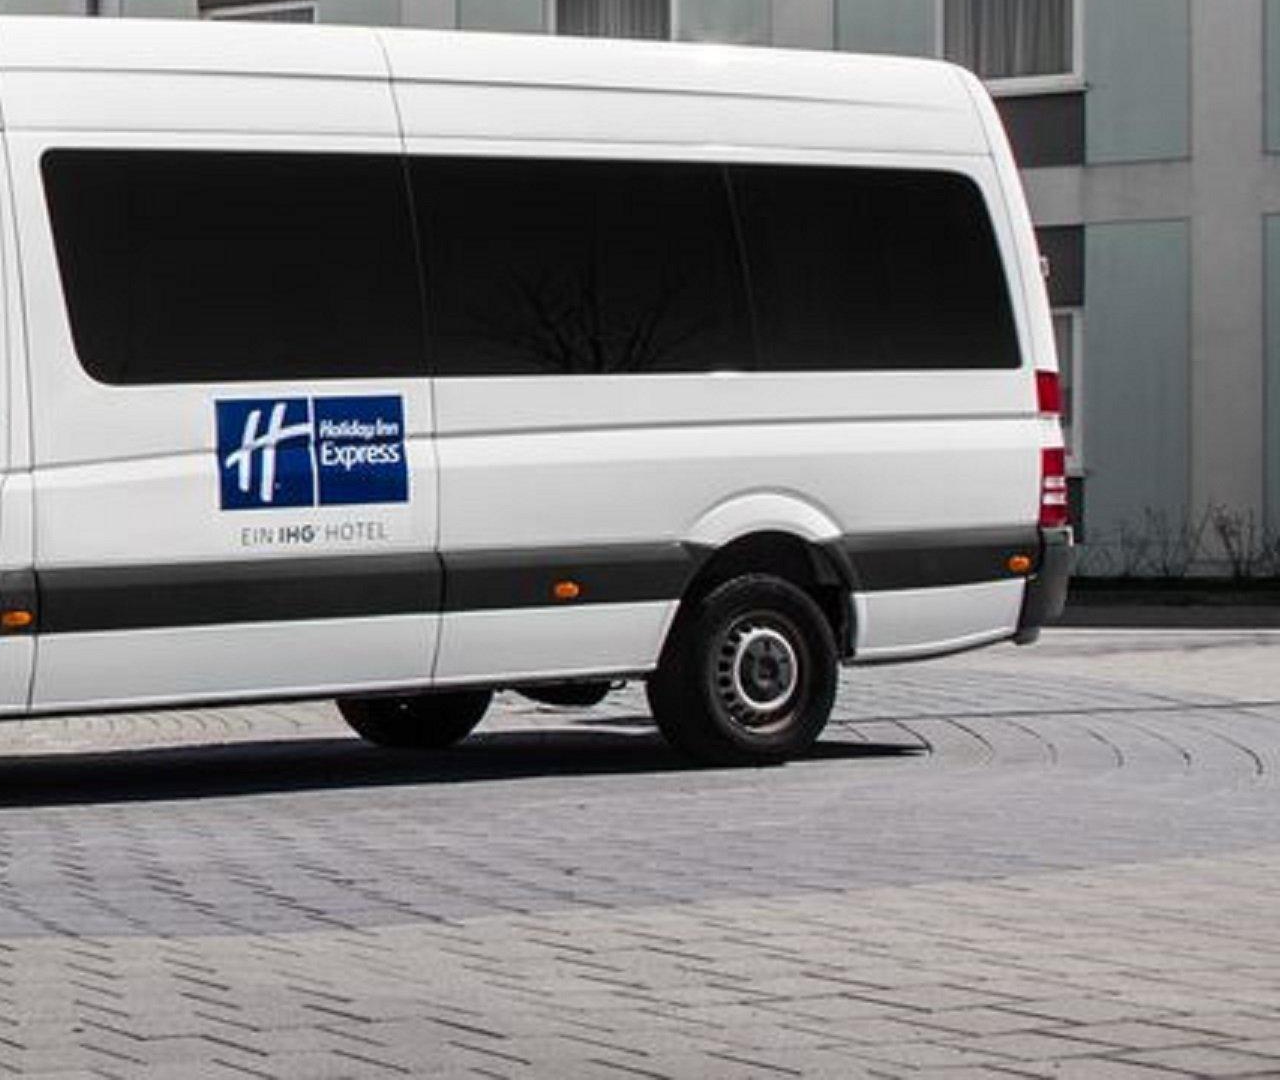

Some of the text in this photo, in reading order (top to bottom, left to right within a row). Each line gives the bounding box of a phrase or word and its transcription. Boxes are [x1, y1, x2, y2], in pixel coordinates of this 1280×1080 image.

[319, 417, 400, 439] Holiday Inn
[320, 440, 401, 470] Express
[241, 528, 274, 547] EIN
[325, 521, 388, 542] HOTEL
